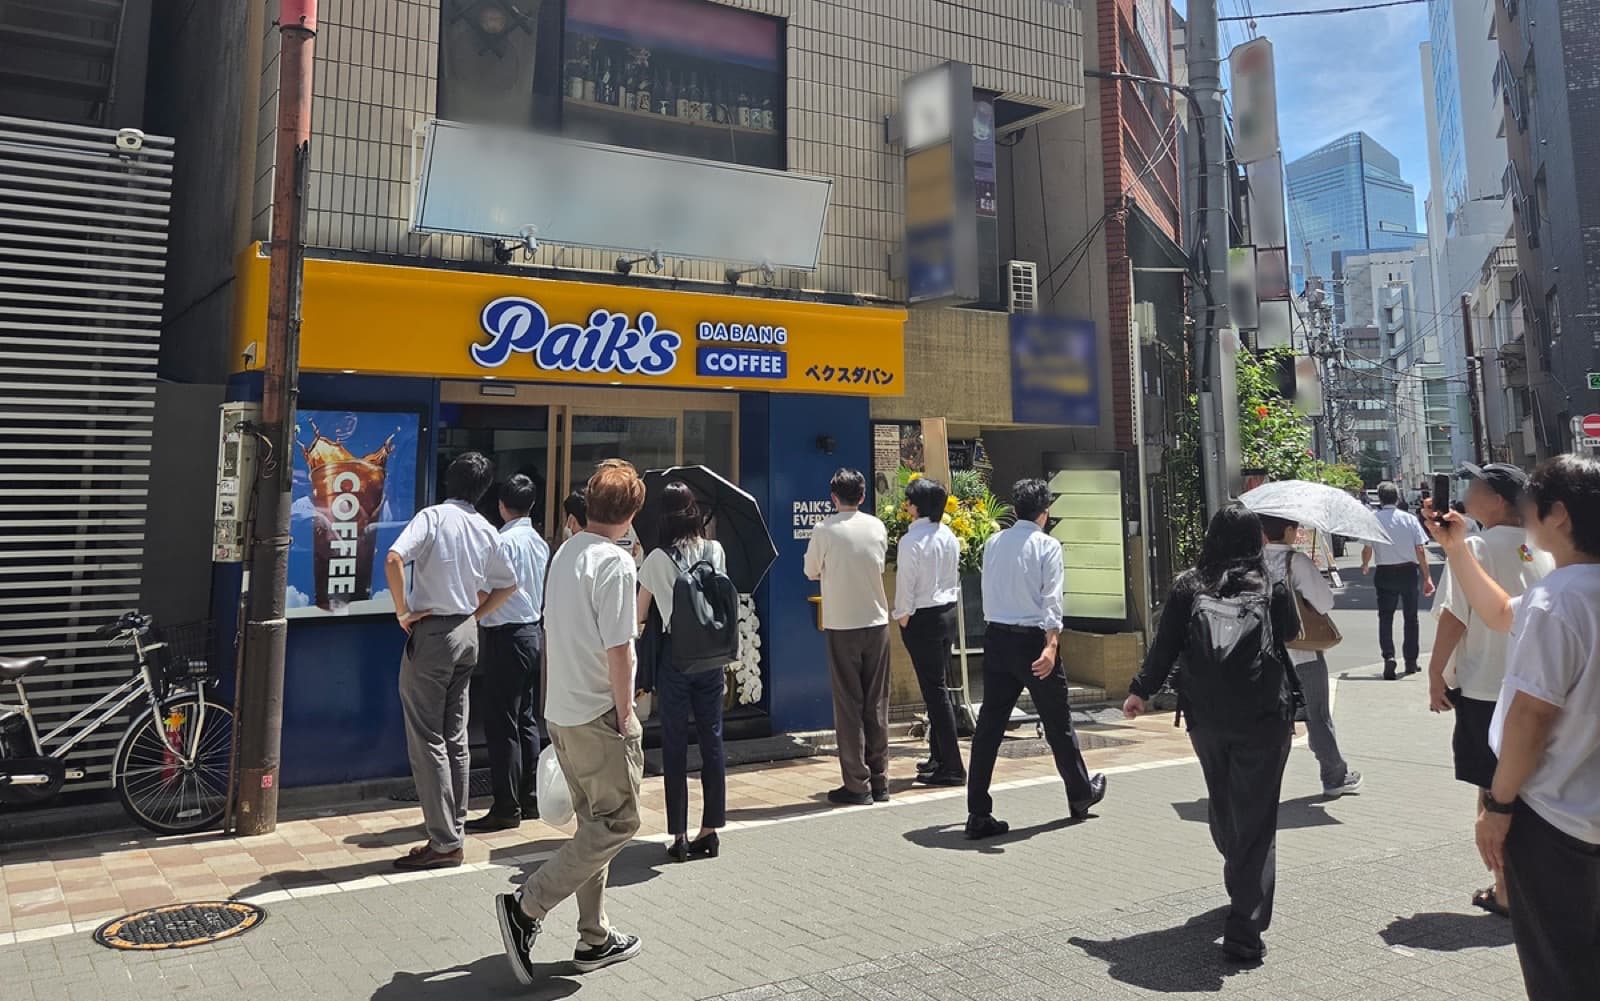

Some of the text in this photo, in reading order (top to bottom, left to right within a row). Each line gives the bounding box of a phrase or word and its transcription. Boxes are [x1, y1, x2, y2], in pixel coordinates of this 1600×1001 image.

[471, 296, 682, 375] Paik's
[699, 321, 788, 345] DABANG
[705, 352, 782, 374] COFFEE
[793, 501, 832, 513] PAIK'S
[328, 471, 361, 595] COFFEE
